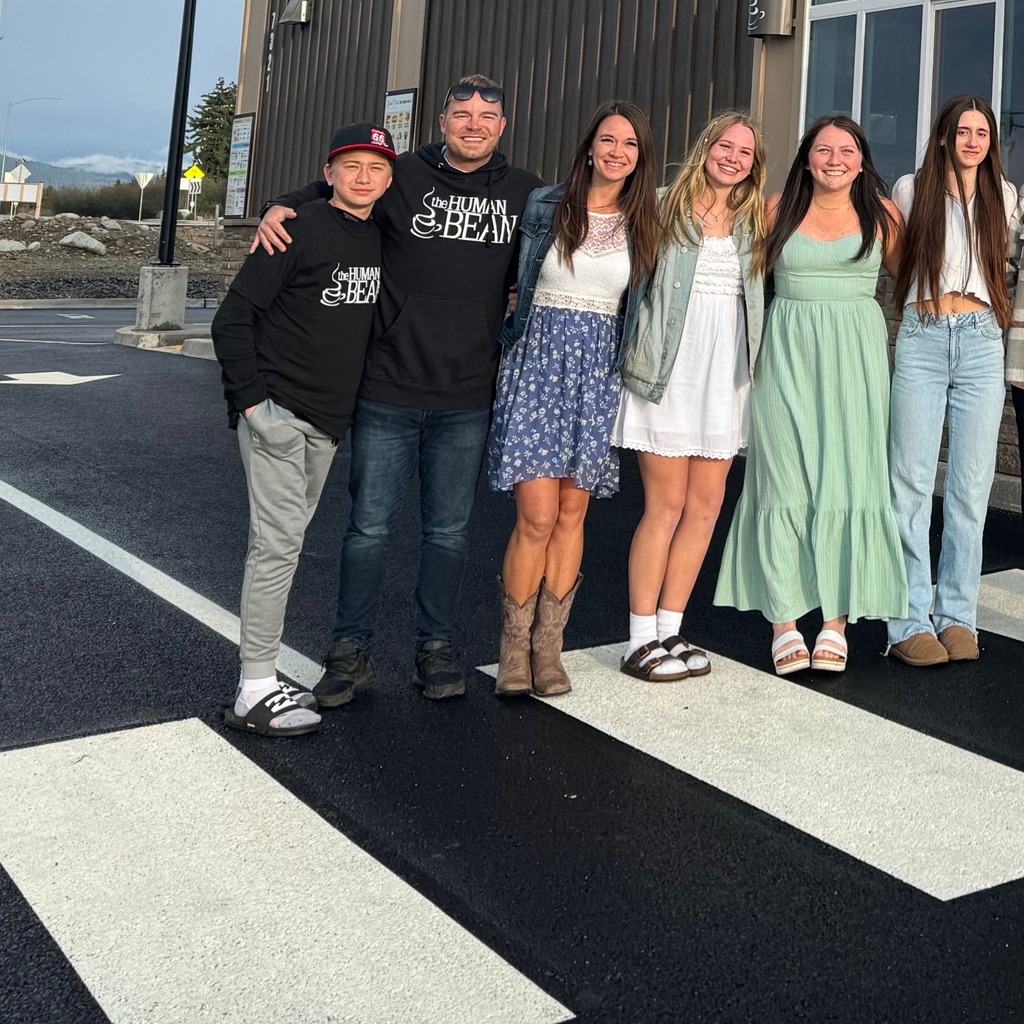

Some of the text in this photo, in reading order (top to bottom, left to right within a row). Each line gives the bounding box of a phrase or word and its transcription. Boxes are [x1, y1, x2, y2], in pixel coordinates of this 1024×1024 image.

[430, 195, 507, 215] the HUMAN
[439, 209, 518, 243] BEAN
[337, 267, 381, 281] the HUMAN
